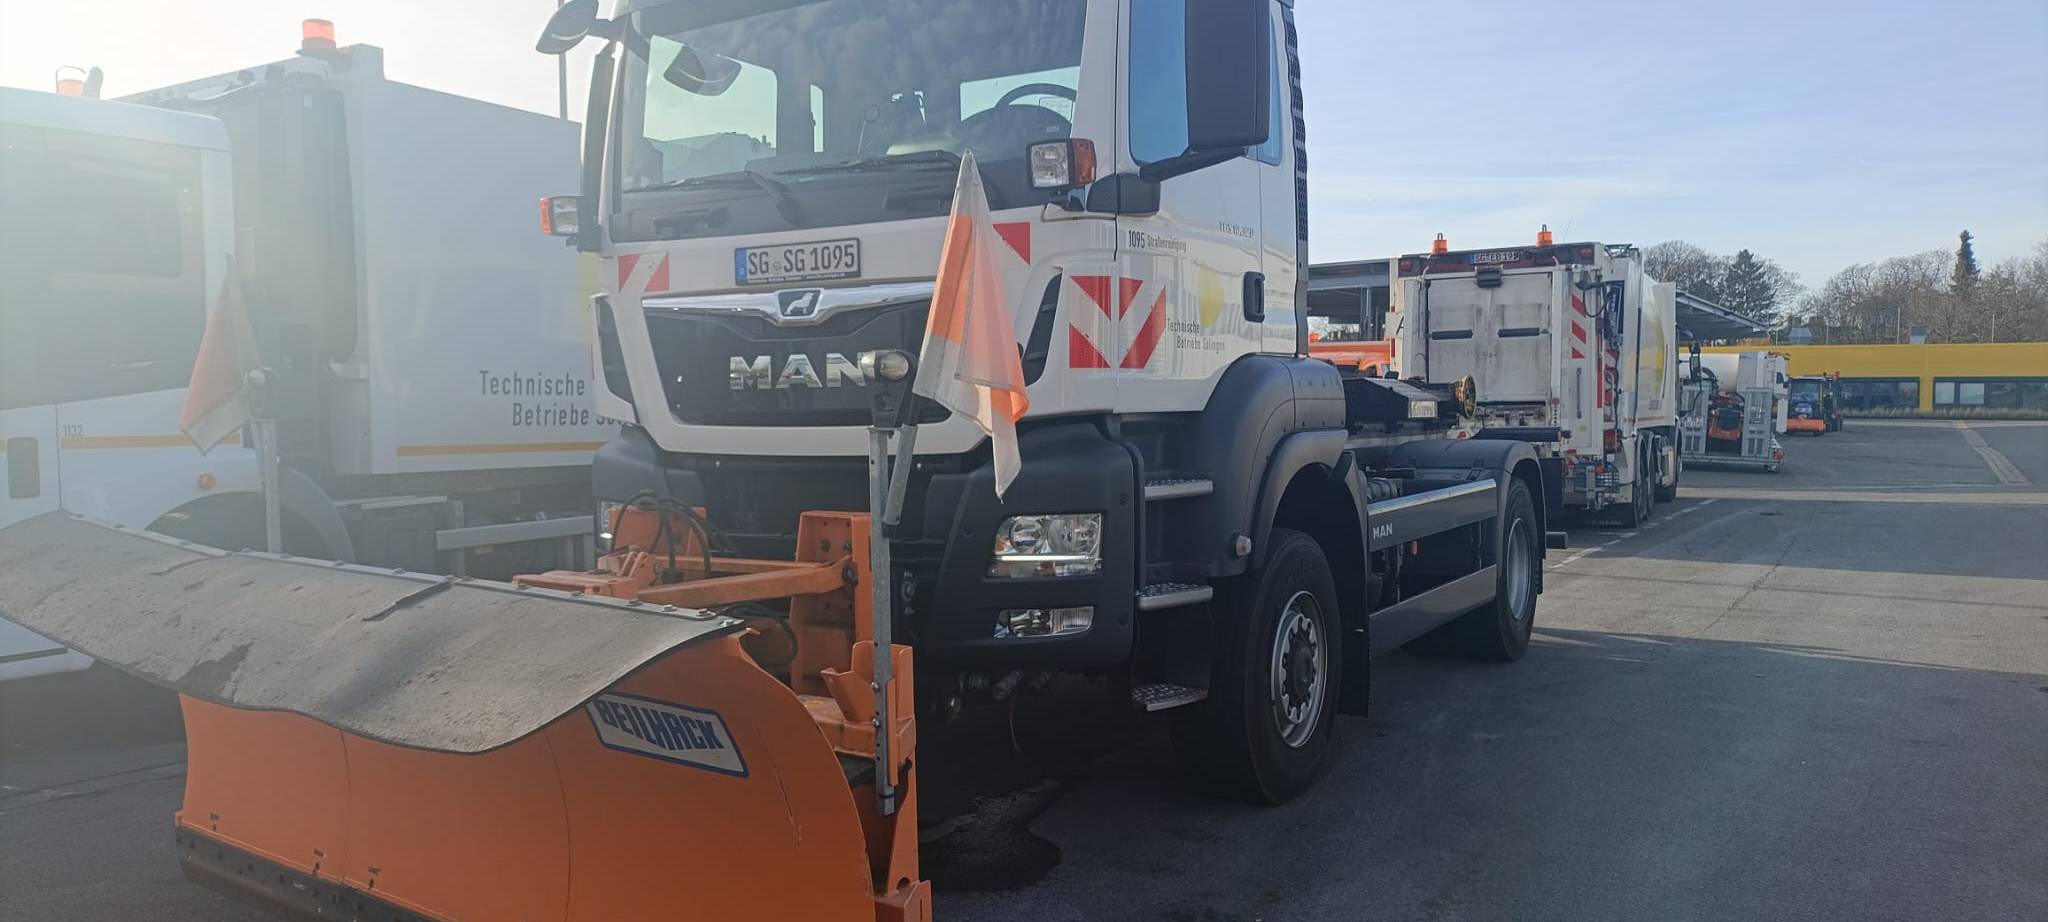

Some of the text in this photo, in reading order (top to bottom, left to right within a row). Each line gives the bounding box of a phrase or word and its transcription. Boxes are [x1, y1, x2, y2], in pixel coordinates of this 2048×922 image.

[1128, 230, 1146, 249] 1095
[748, 244, 855, 275] SG SG 1095
[1167, 317, 1200, 333] Technische
[479, 370, 585, 396] Technische
[730, 353, 866, 389] MAN
[512, 402, 589, 426] Betriebe
[1372, 523, 1393, 540] MAN
